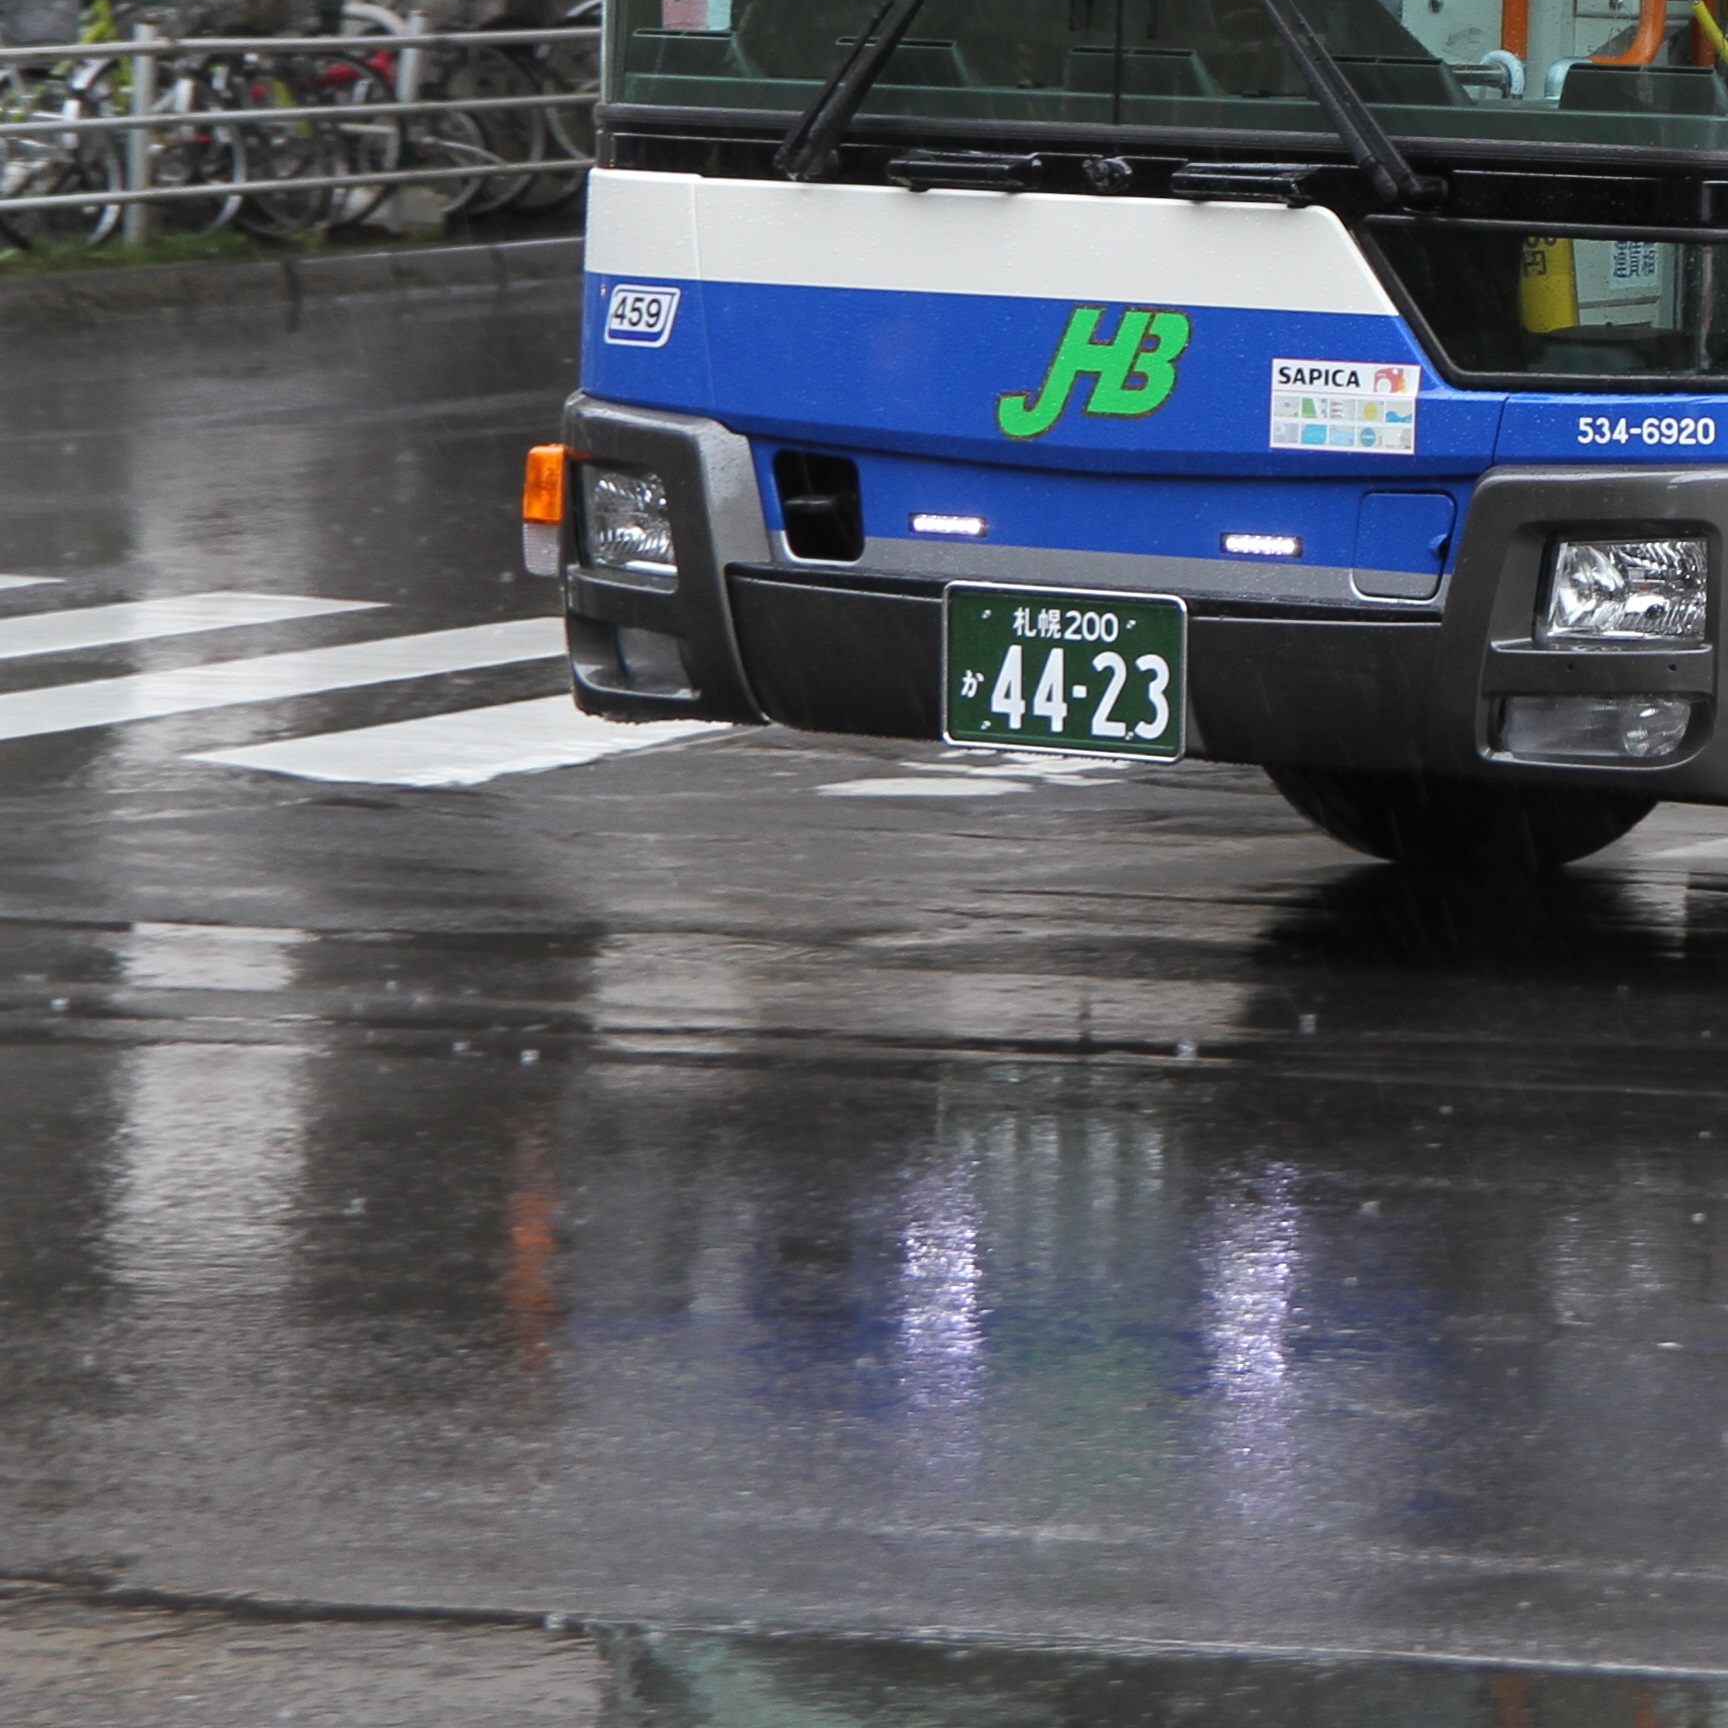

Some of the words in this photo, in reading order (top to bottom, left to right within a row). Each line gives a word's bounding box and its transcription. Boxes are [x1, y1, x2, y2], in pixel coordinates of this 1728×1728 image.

[613, 295, 662, 328] 459
[1278, 366, 1362, 388] SAPICA
[1577, 416, 1716, 446] 534-6920
[960, 669, 985, 699] か
[991, 644, 1170, 740] 44-23
